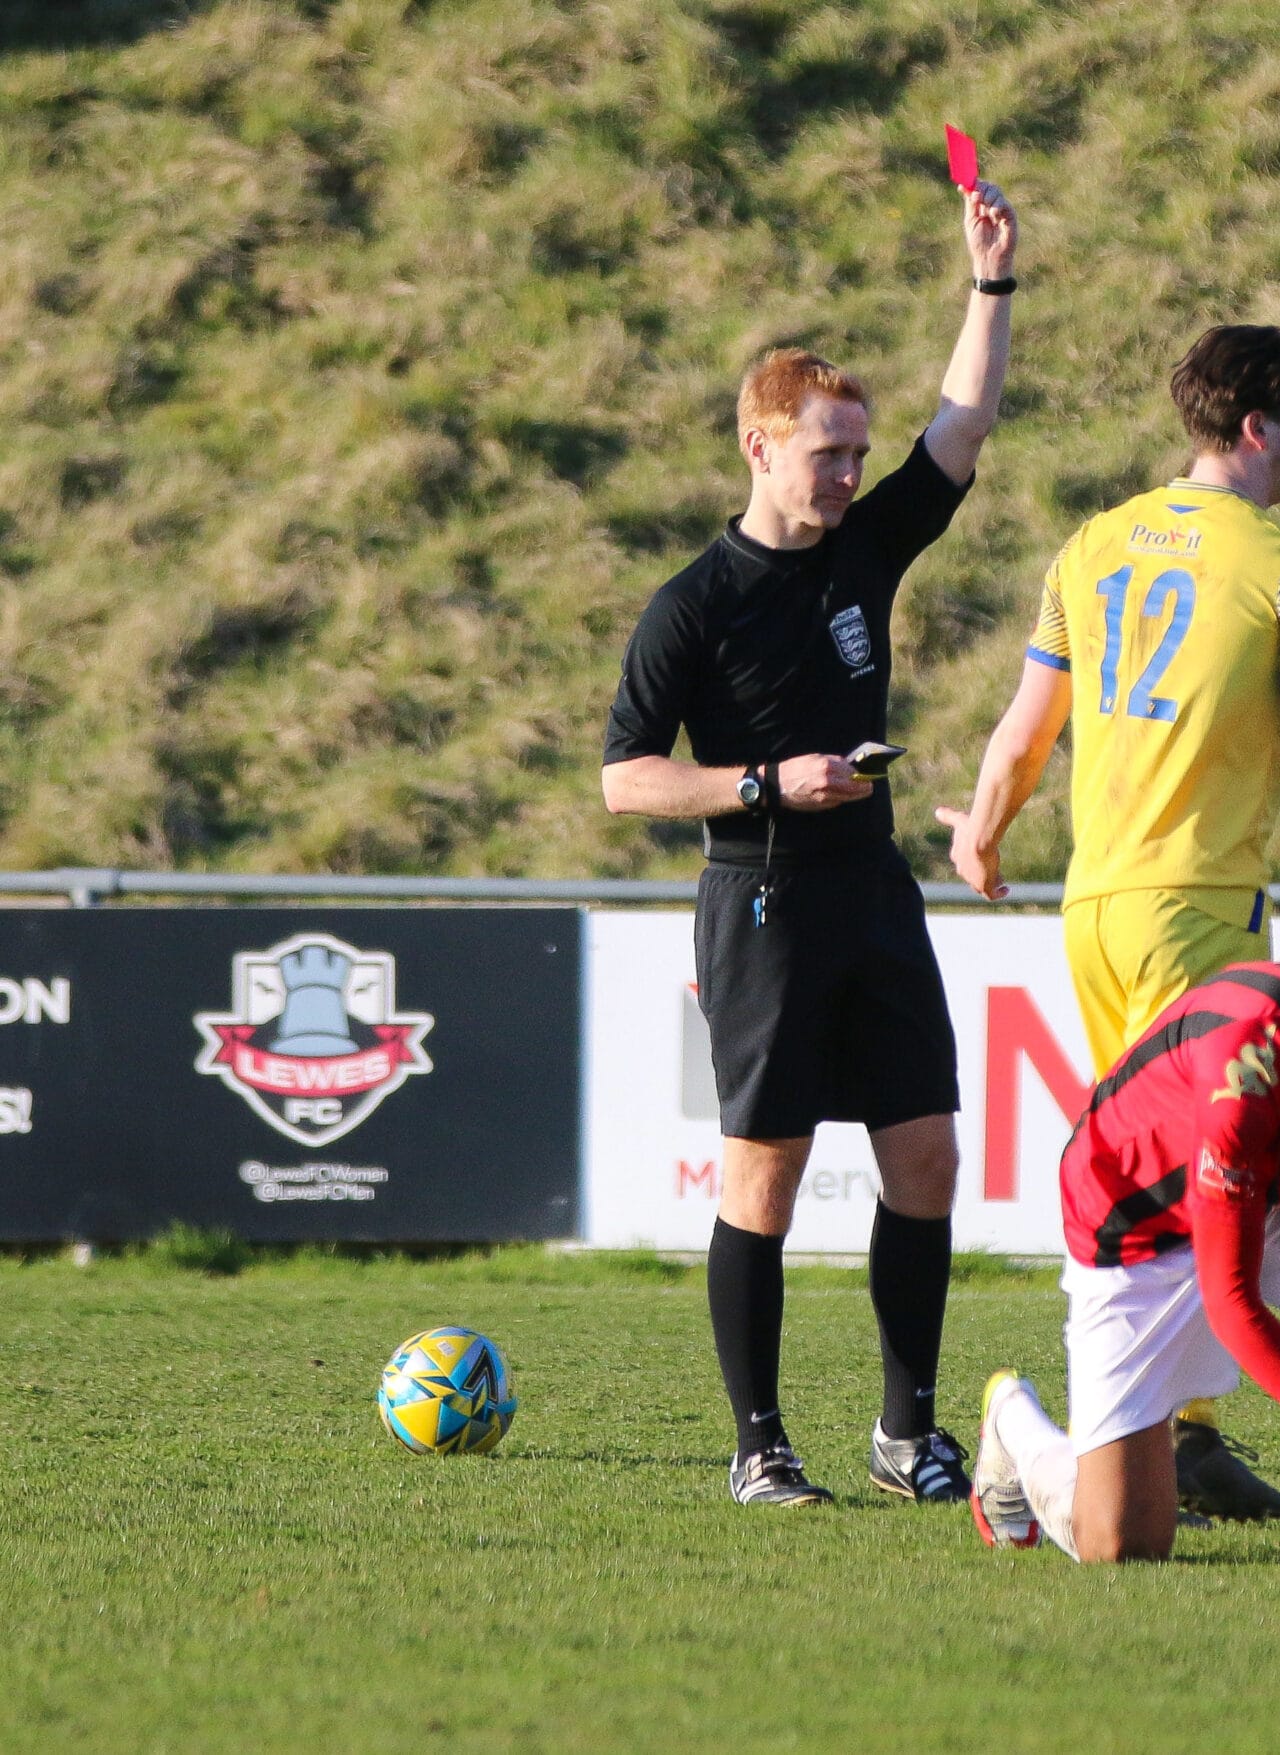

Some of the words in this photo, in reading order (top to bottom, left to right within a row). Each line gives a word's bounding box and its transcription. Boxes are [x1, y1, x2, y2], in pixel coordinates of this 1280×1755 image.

[1095, 565, 1197, 722] 12
[234, 1050, 391, 1090] LEWES
[284, 1097, 343, 1126] FC
